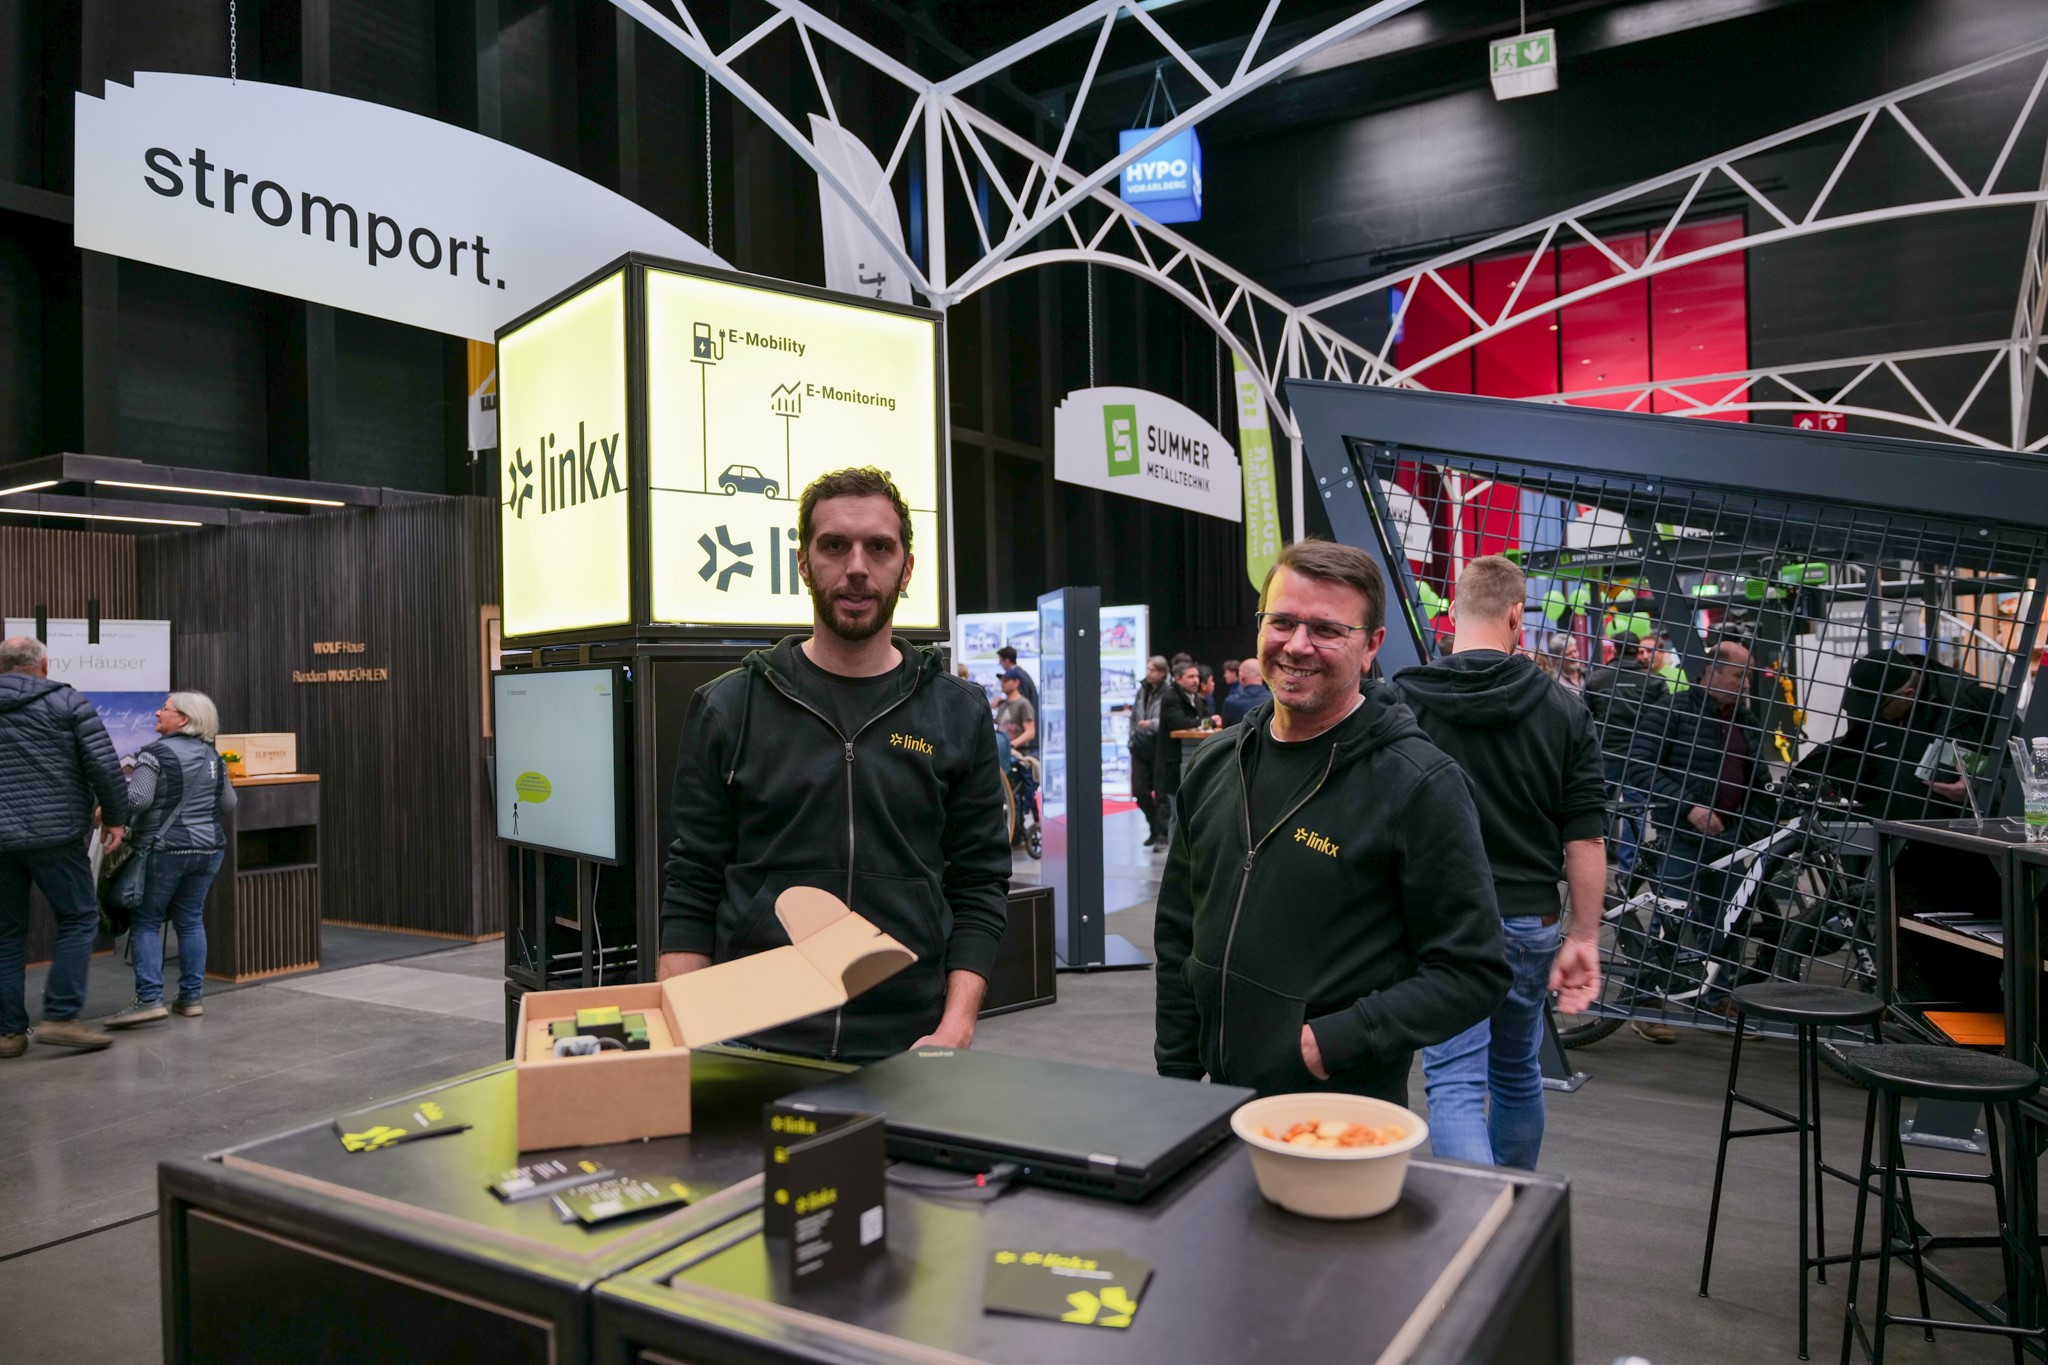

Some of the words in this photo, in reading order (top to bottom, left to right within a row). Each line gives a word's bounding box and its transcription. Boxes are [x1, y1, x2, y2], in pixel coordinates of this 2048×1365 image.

[1126, 159, 1188, 182] HYPO
[1127, 180, 1187, 194] VORARLBERG
[144, 147, 505, 290] stromport.
[728, 329, 806, 357] E-Mobility
[806, 383, 896, 411] E-Monitoring
[1147, 425, 1210, 469] SUMMER
[540, 421, 620, 515] linkx
[1147, 462, 1210, 492] METALLTECHNIK
[313, 642, 342, 654] WOLF
[342, 641, 365, 653] Haus
[79, 653, 146, 670] Häuser
[327, 667, 388, 681] WOLFÜHLEN
[903, 734, 934, 755] linkx
[1305, 831, 1340, 857] linkx
